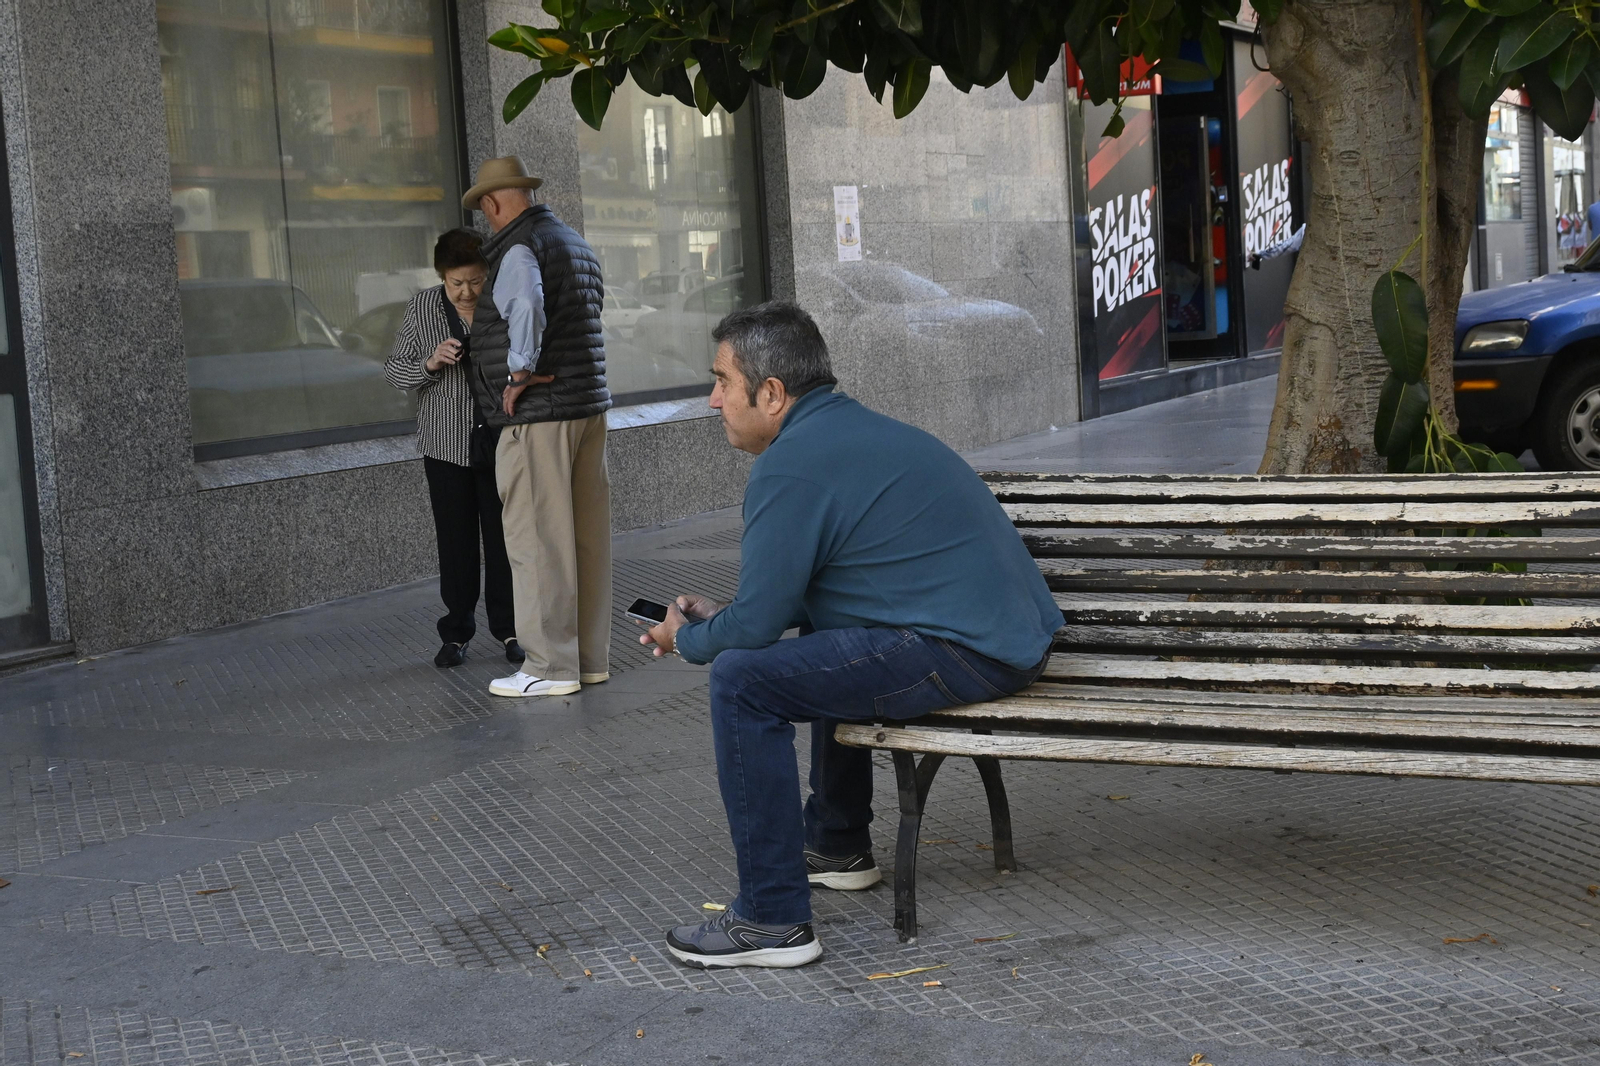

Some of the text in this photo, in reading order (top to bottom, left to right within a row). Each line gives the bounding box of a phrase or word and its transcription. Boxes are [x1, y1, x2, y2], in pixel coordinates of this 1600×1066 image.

[1089, 188, 1152, 263] SALAS
[1243, 159, 1289, 221] SALAS
[1245, 200, 1292, 268] POKER
[1092, 236, 1157, 318] POKER
